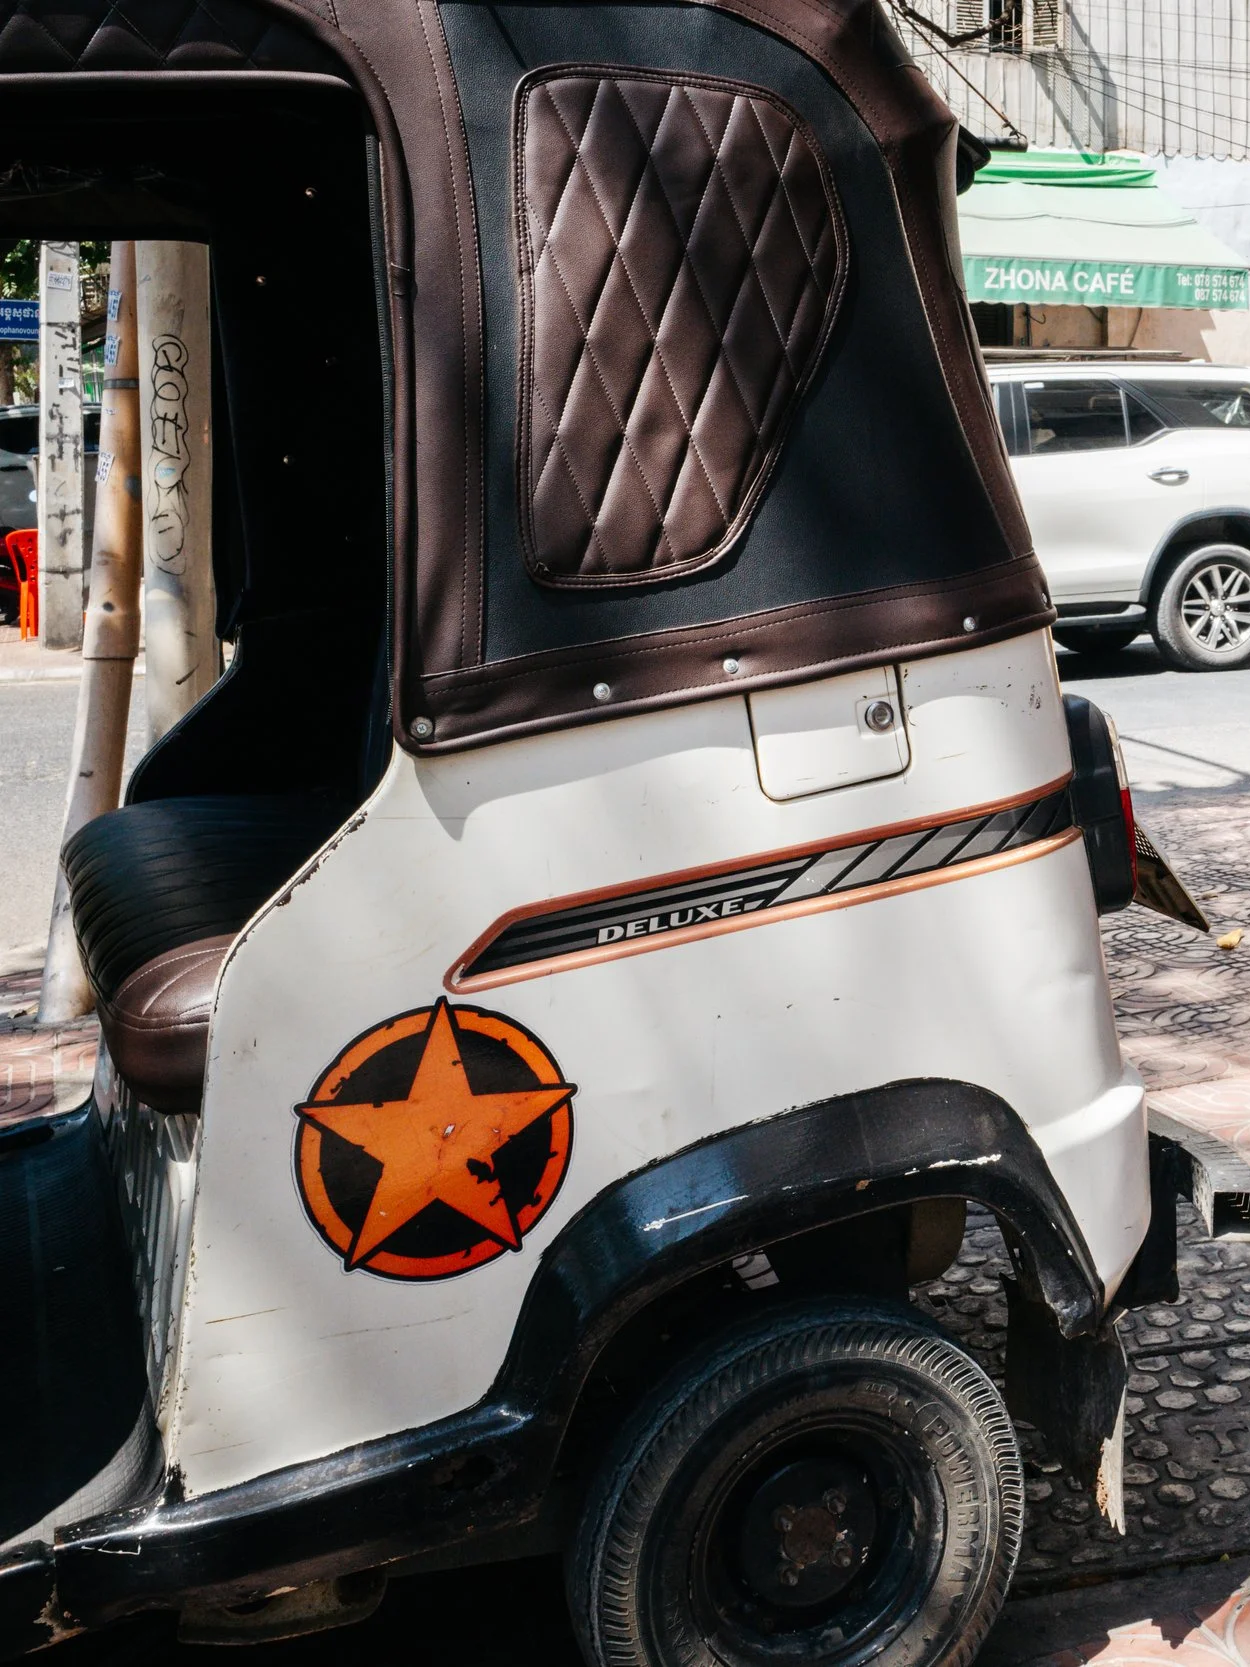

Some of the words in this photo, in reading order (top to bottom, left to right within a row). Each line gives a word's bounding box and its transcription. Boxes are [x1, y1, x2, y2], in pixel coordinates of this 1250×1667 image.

[984, 267, 1068, 291] ZHONA
[1073, 267, 1135, 294] CAFÉ
[1176, 272, 1192, 286] Tel:
[1194, 273, 1210, 287] 078
[1212, 274, 1228, 288] 574
[1229, 274, 1245, 289] 674
[1194, 288, 1210, 301] 087
[1212, 289, 1228, 302] 574
[1229, 290, 1245, 302] 674
[597, 897, 744, 944] DELUXE
